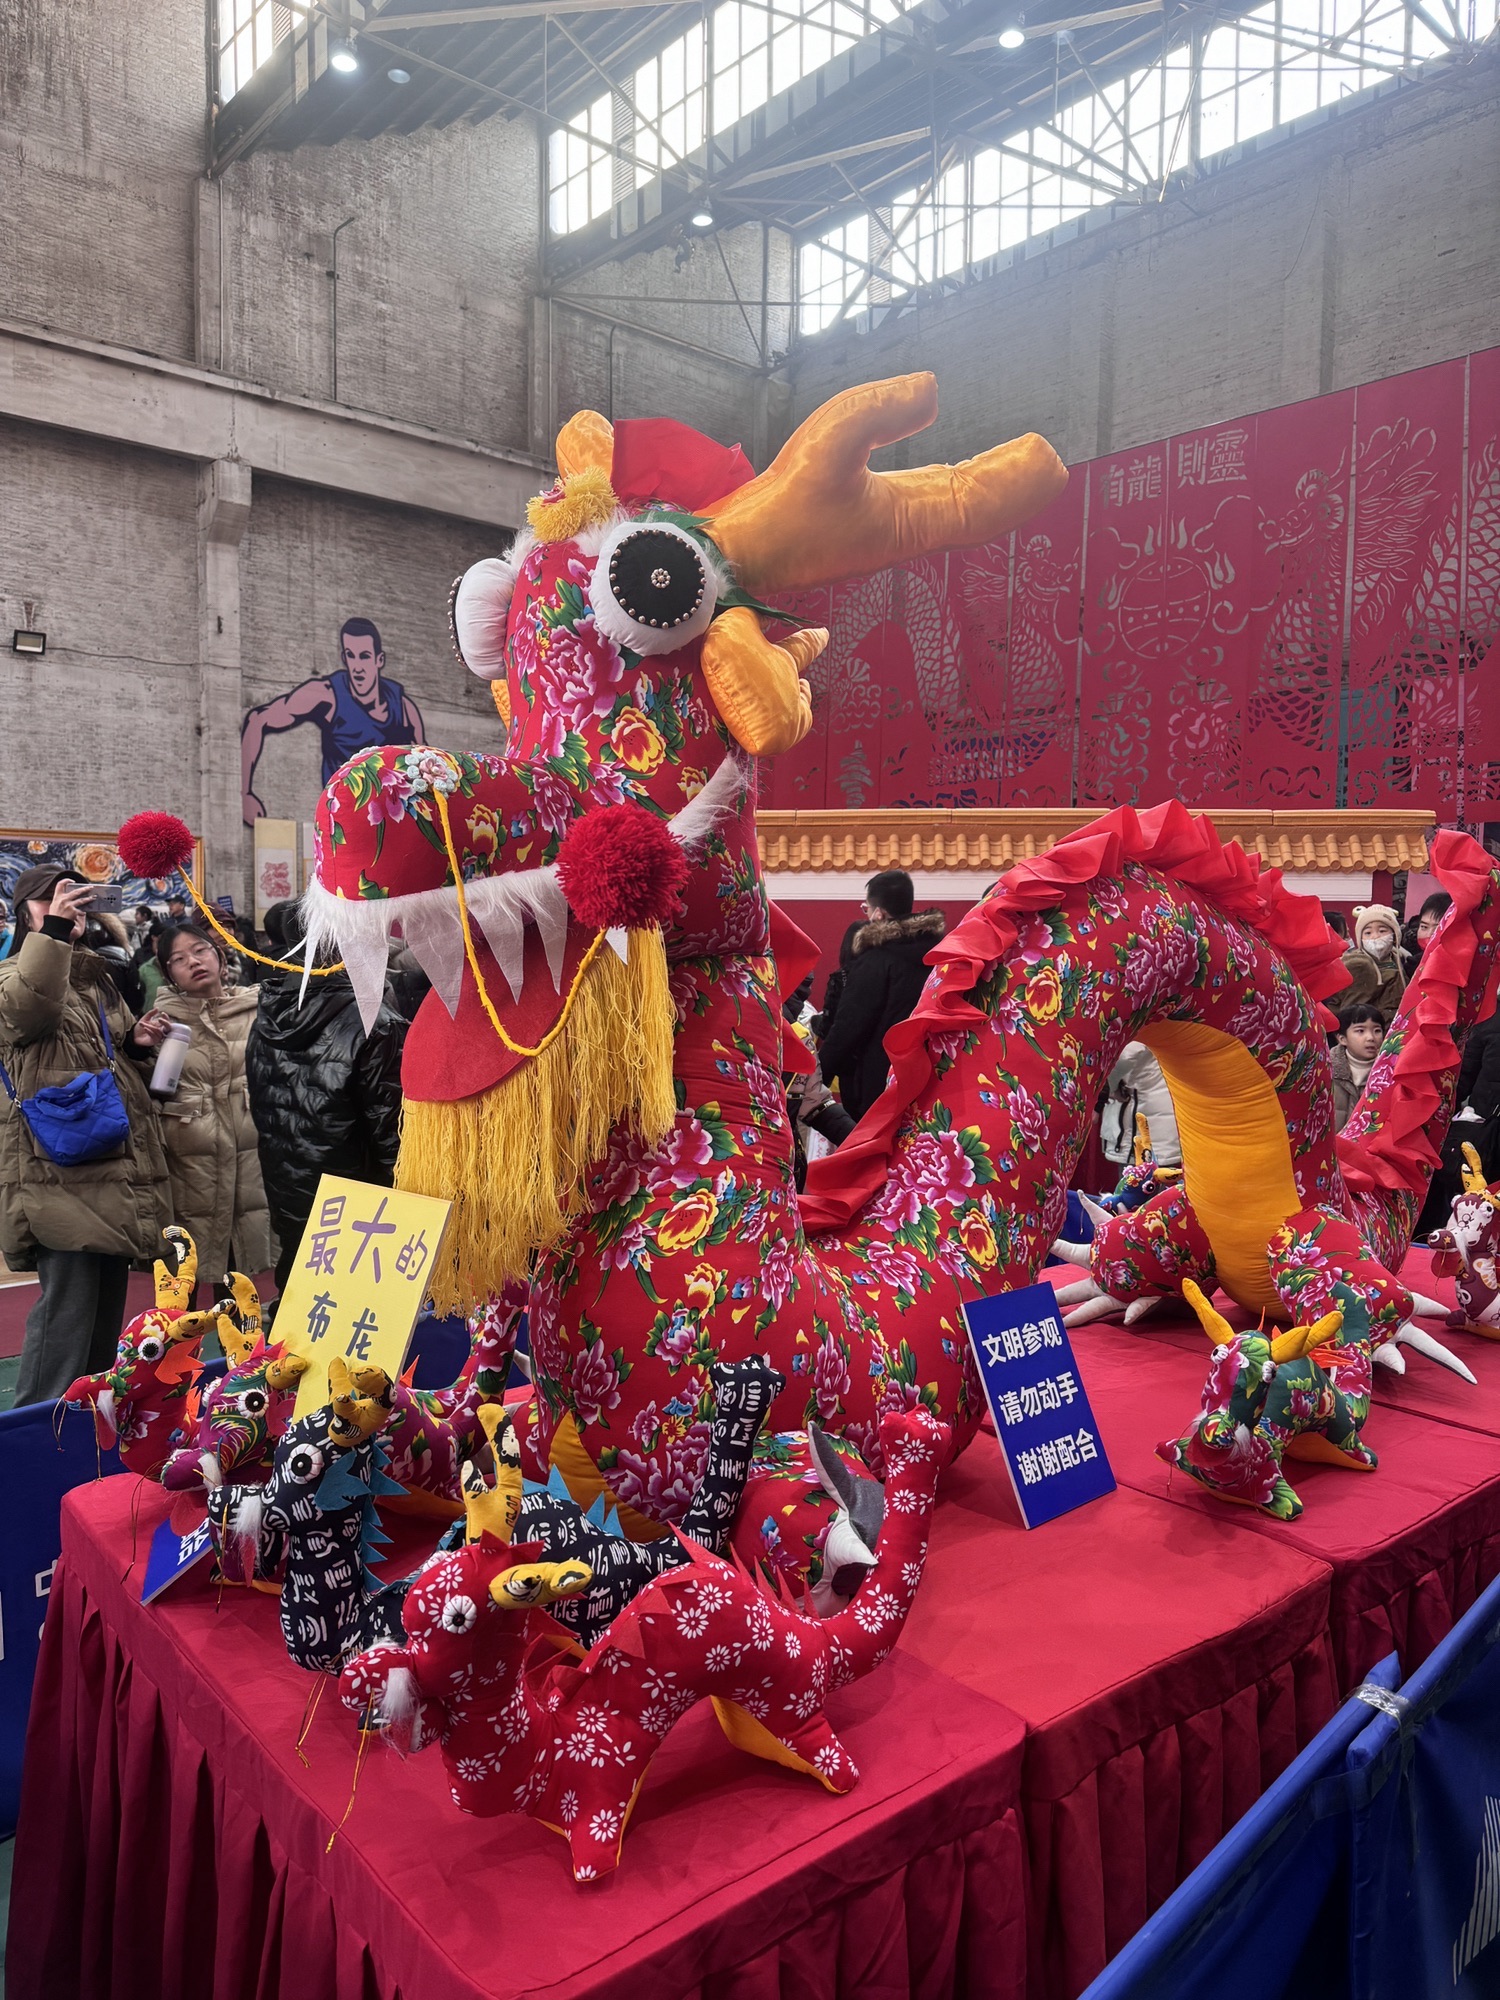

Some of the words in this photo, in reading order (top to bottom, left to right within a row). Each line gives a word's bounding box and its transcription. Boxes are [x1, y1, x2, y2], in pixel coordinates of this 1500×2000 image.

[305, 1195, 428, 1283] 最大的
[306, 1291, 379, 1361] 布龙
[982, 1316, 1063, 1367] 文明参观
[998, 1371, 1079, 1426] 请勿动手
[1016, 1428, 1098, 1486] 谢谢配合
